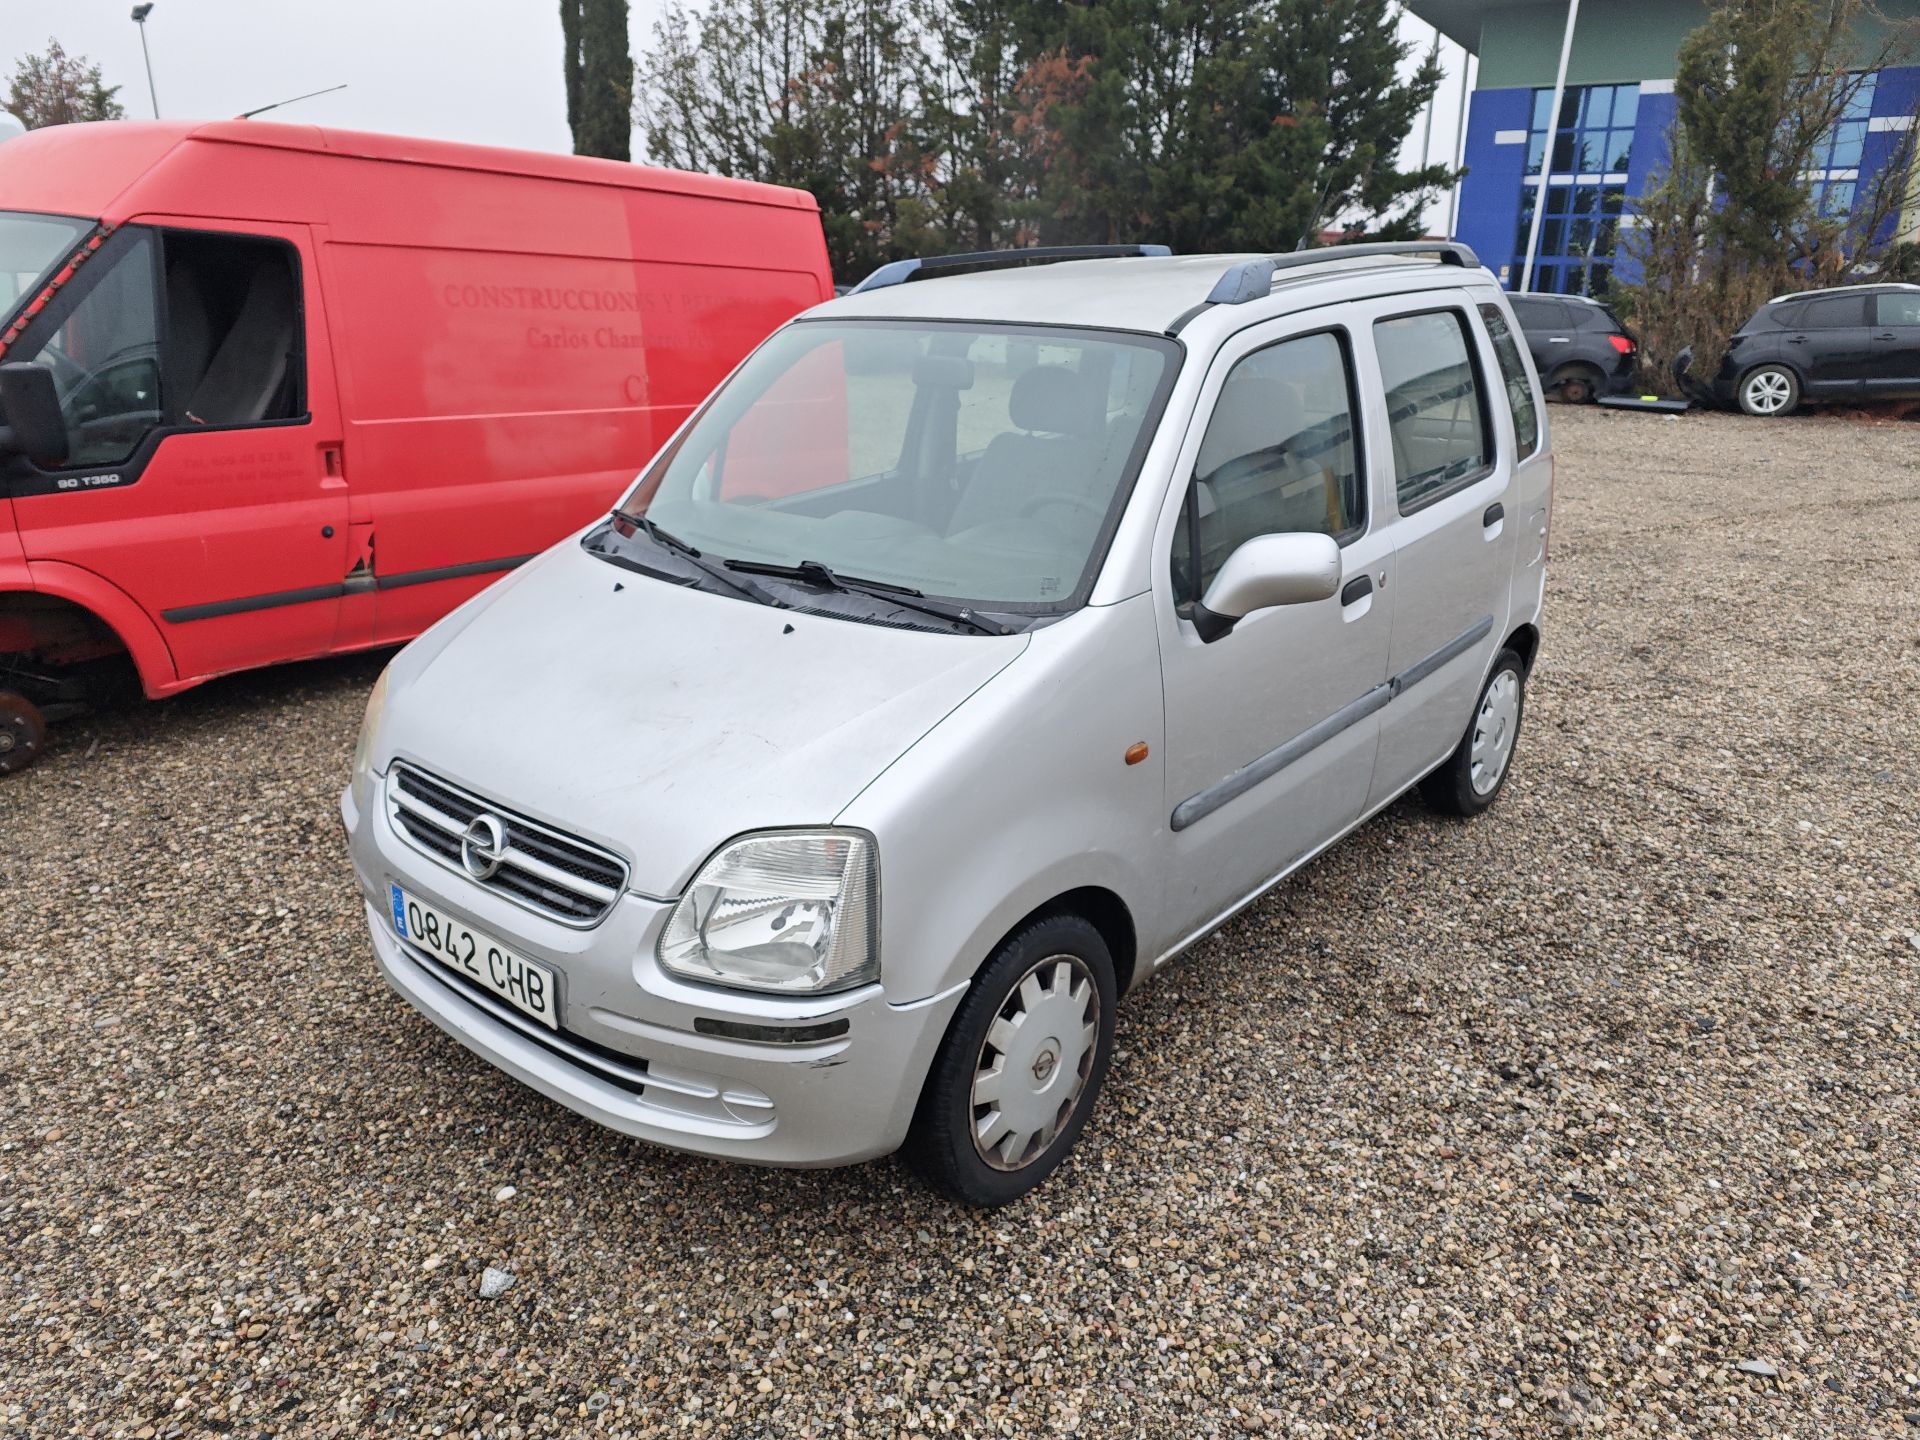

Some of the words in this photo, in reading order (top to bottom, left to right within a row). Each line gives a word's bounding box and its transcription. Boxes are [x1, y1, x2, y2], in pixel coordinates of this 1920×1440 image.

[443, 284, 656, 312] CONSTRUCCIONES
[526, 327, 589, 349] Carlos
[396, 916, 404, 929] E
[408, 901, 480, 976] 0842
[488, 947, 546, 1013] CHB
